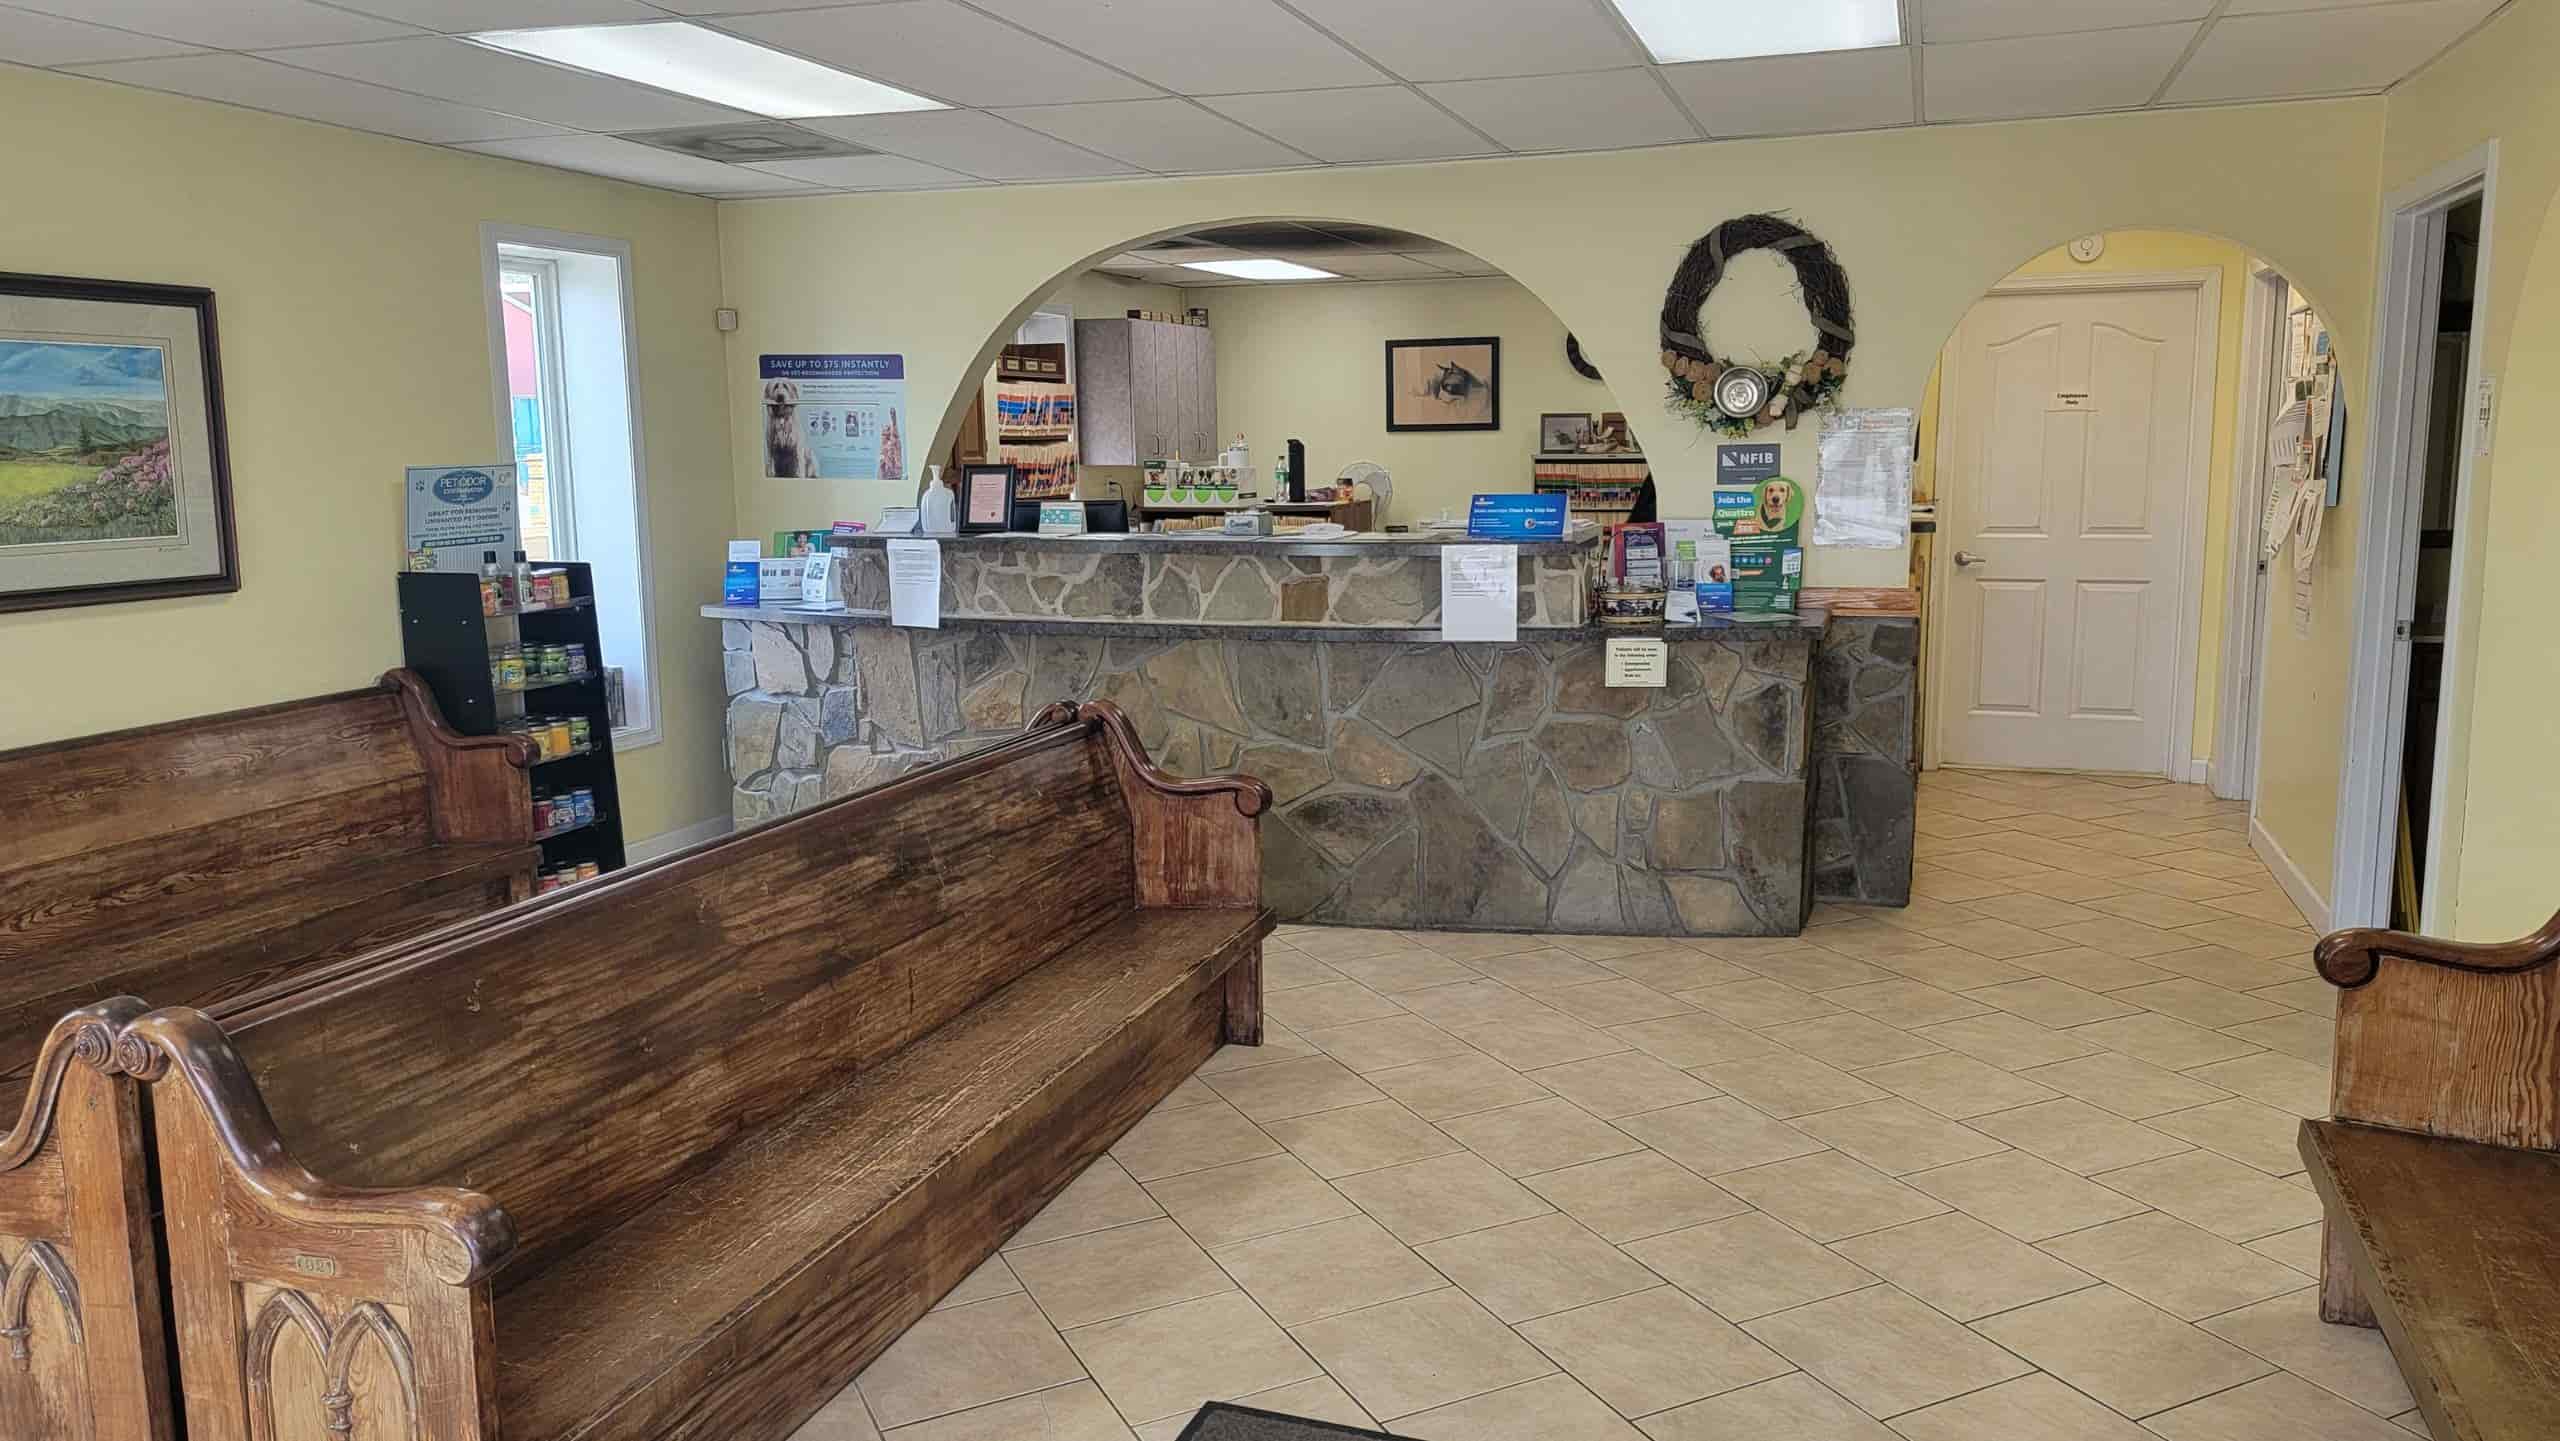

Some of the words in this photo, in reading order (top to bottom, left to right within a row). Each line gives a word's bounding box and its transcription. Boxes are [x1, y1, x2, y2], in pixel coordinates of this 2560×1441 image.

[770, 360, 793, 369] SAVE
[795, 360, 807, 369] UP
[809, 360, 822, 369] TO
[823, 360, 839, 369] $75
[841, 359, 890, 369] INSTANTLY
[1739, 452, 1774, 464] NFIB
[440, 478, 458, 488] PET
[1717, 495, 1735, 504] Join
[1736, 496, 1752, 504] the
[1717, 509, 1755, 518] Quattro
